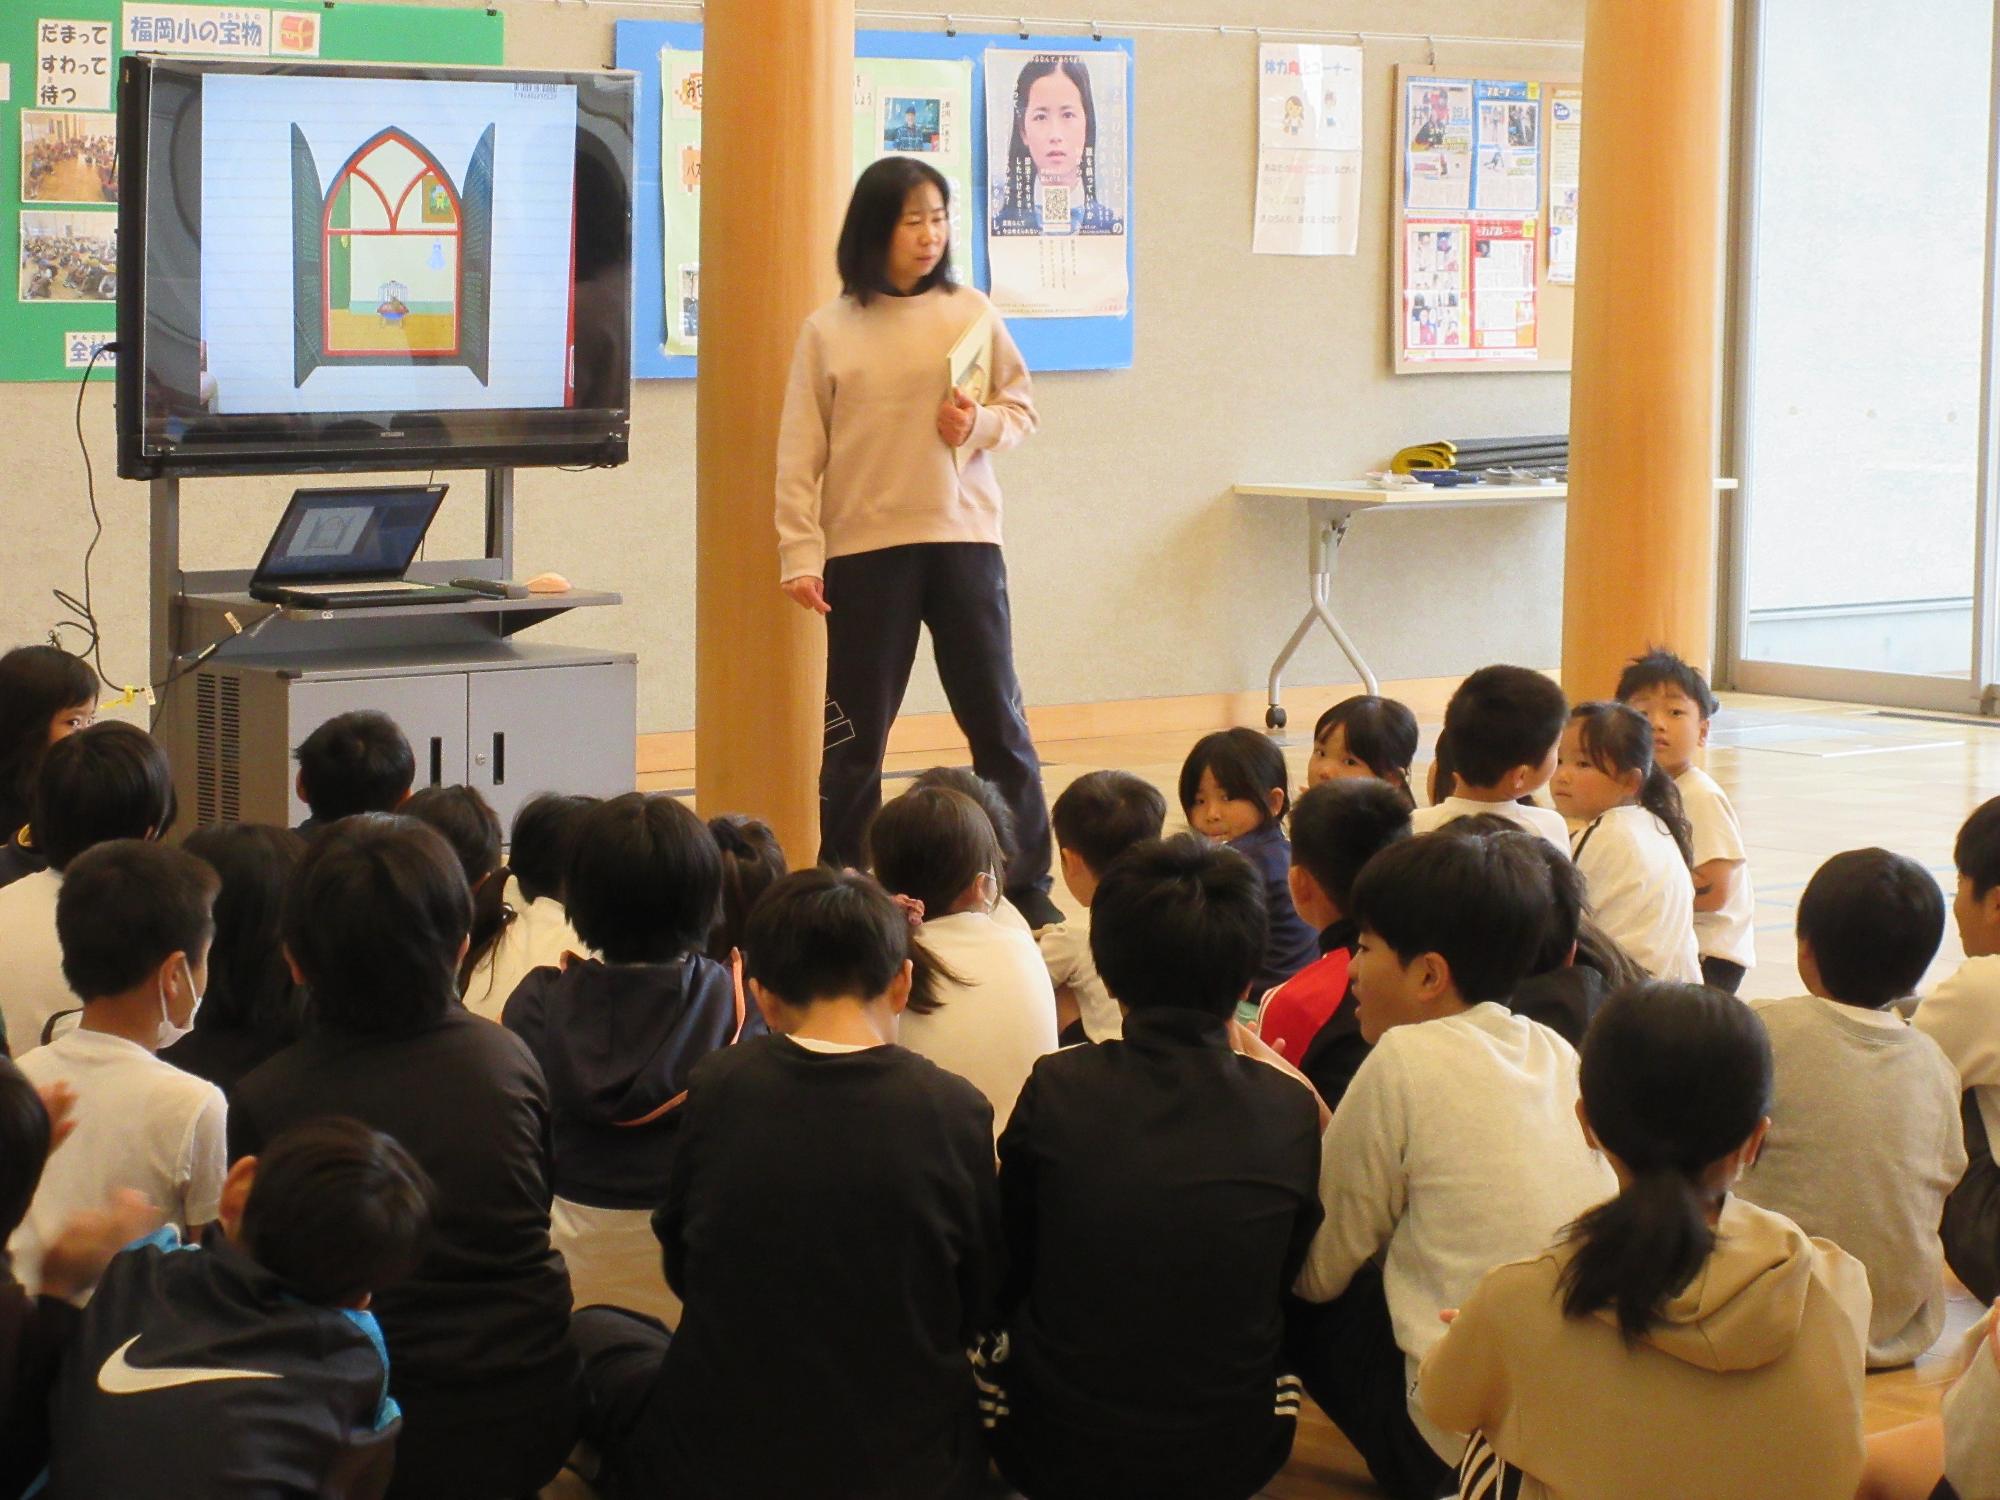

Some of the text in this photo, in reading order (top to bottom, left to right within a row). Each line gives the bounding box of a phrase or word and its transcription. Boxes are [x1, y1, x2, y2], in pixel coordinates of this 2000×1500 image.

[41, 23, 108, 44] だまって
[130, 16, 262, 46] 福岡小の宝物
[41, 54, 107, 75] すわって
[40, 84, 77, 105] 待つ
